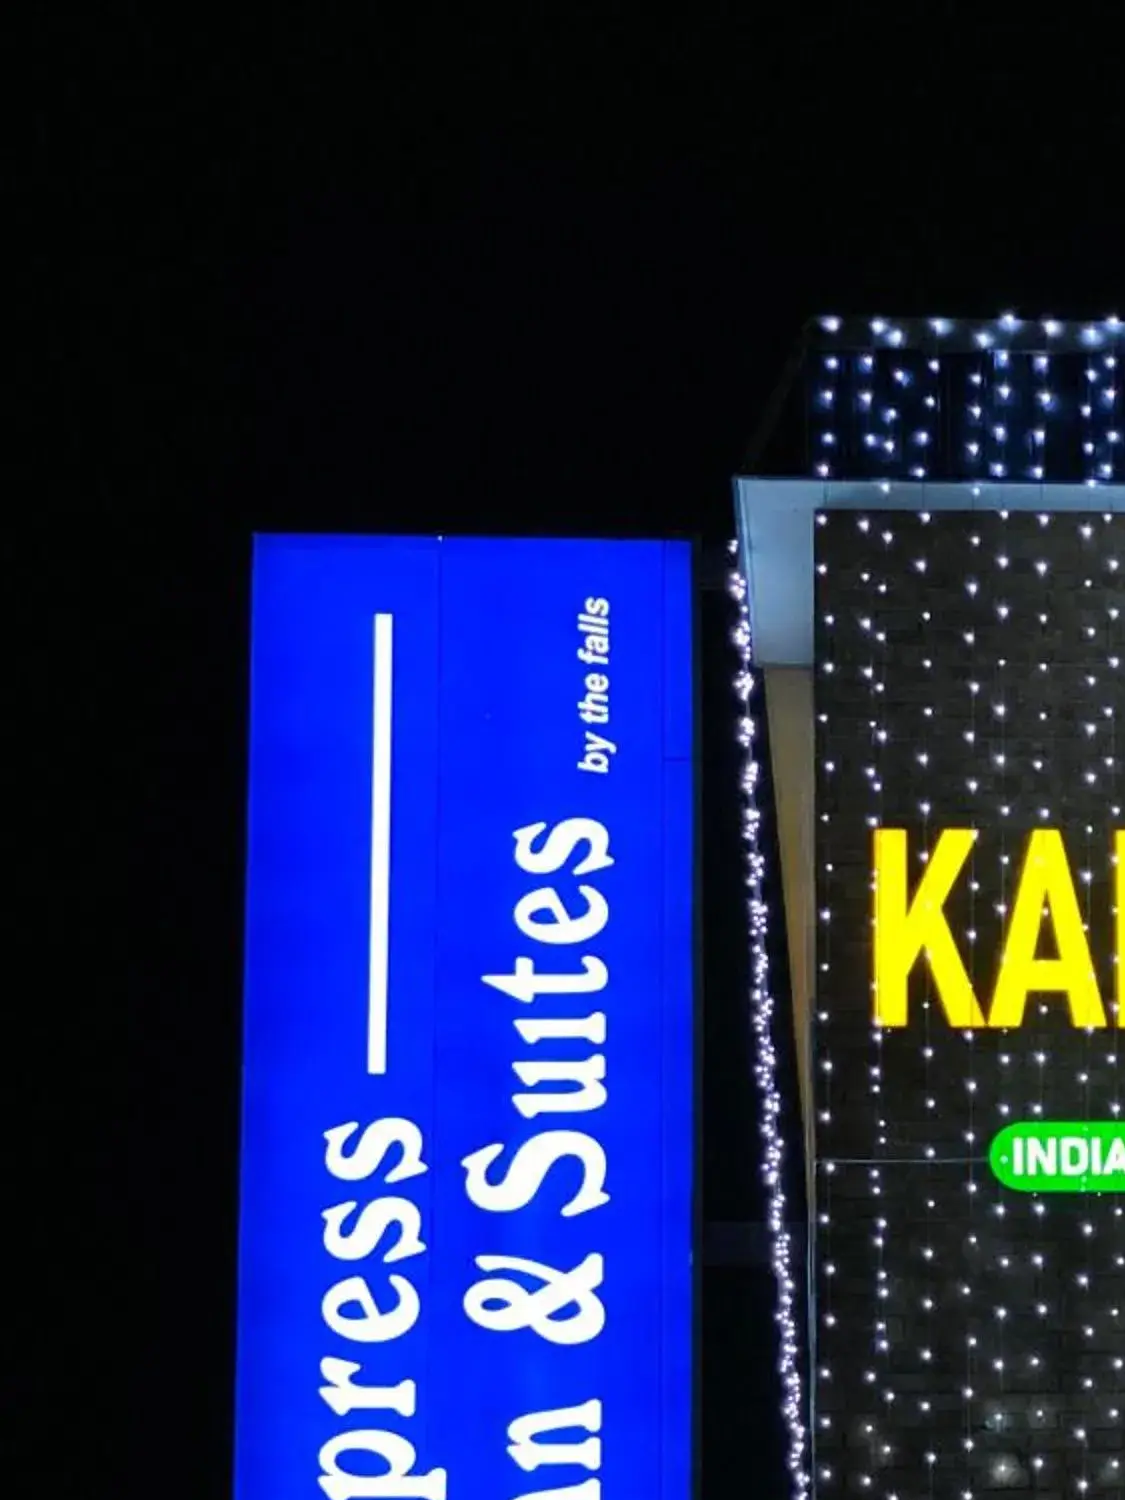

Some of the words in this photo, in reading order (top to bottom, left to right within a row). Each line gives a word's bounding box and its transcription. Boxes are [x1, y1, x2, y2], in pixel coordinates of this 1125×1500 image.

[576, 597, 611, 665] falls
[577, 673, 610, 724] the
[577, 731, 616, 773] by
[461, 816, 614, 1218] Suites
[463, 1252, 606, 1345] &
